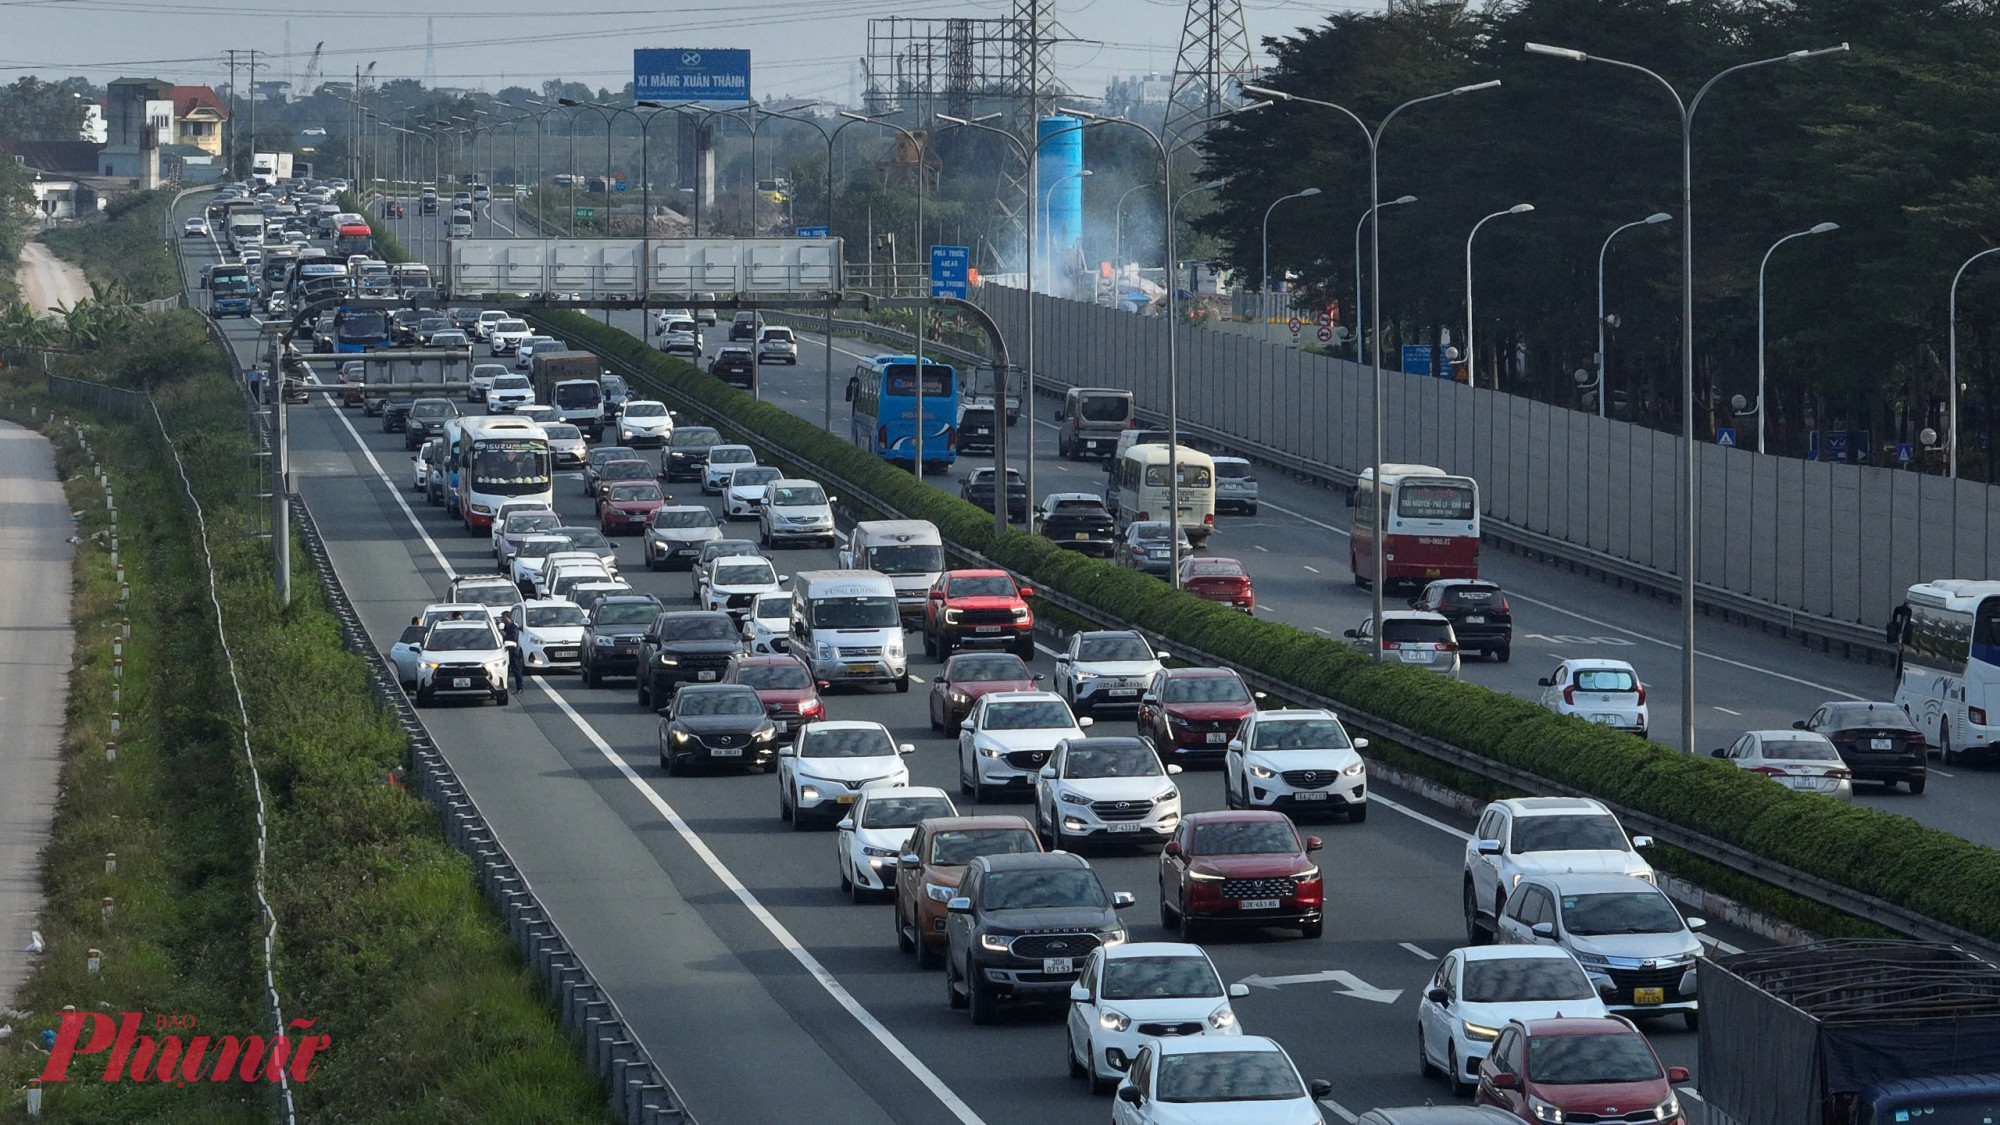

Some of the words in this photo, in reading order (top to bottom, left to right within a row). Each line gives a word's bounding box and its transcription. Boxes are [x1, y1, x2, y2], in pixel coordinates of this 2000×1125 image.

[637, 75, 648, 88] XI
[650, 73, 680, 88] MĂNG
[683, 73, 710, 88] XUÂN
[712, 73, 745, 88] THÀNH
[1524, 633, 1637, 646] 100
